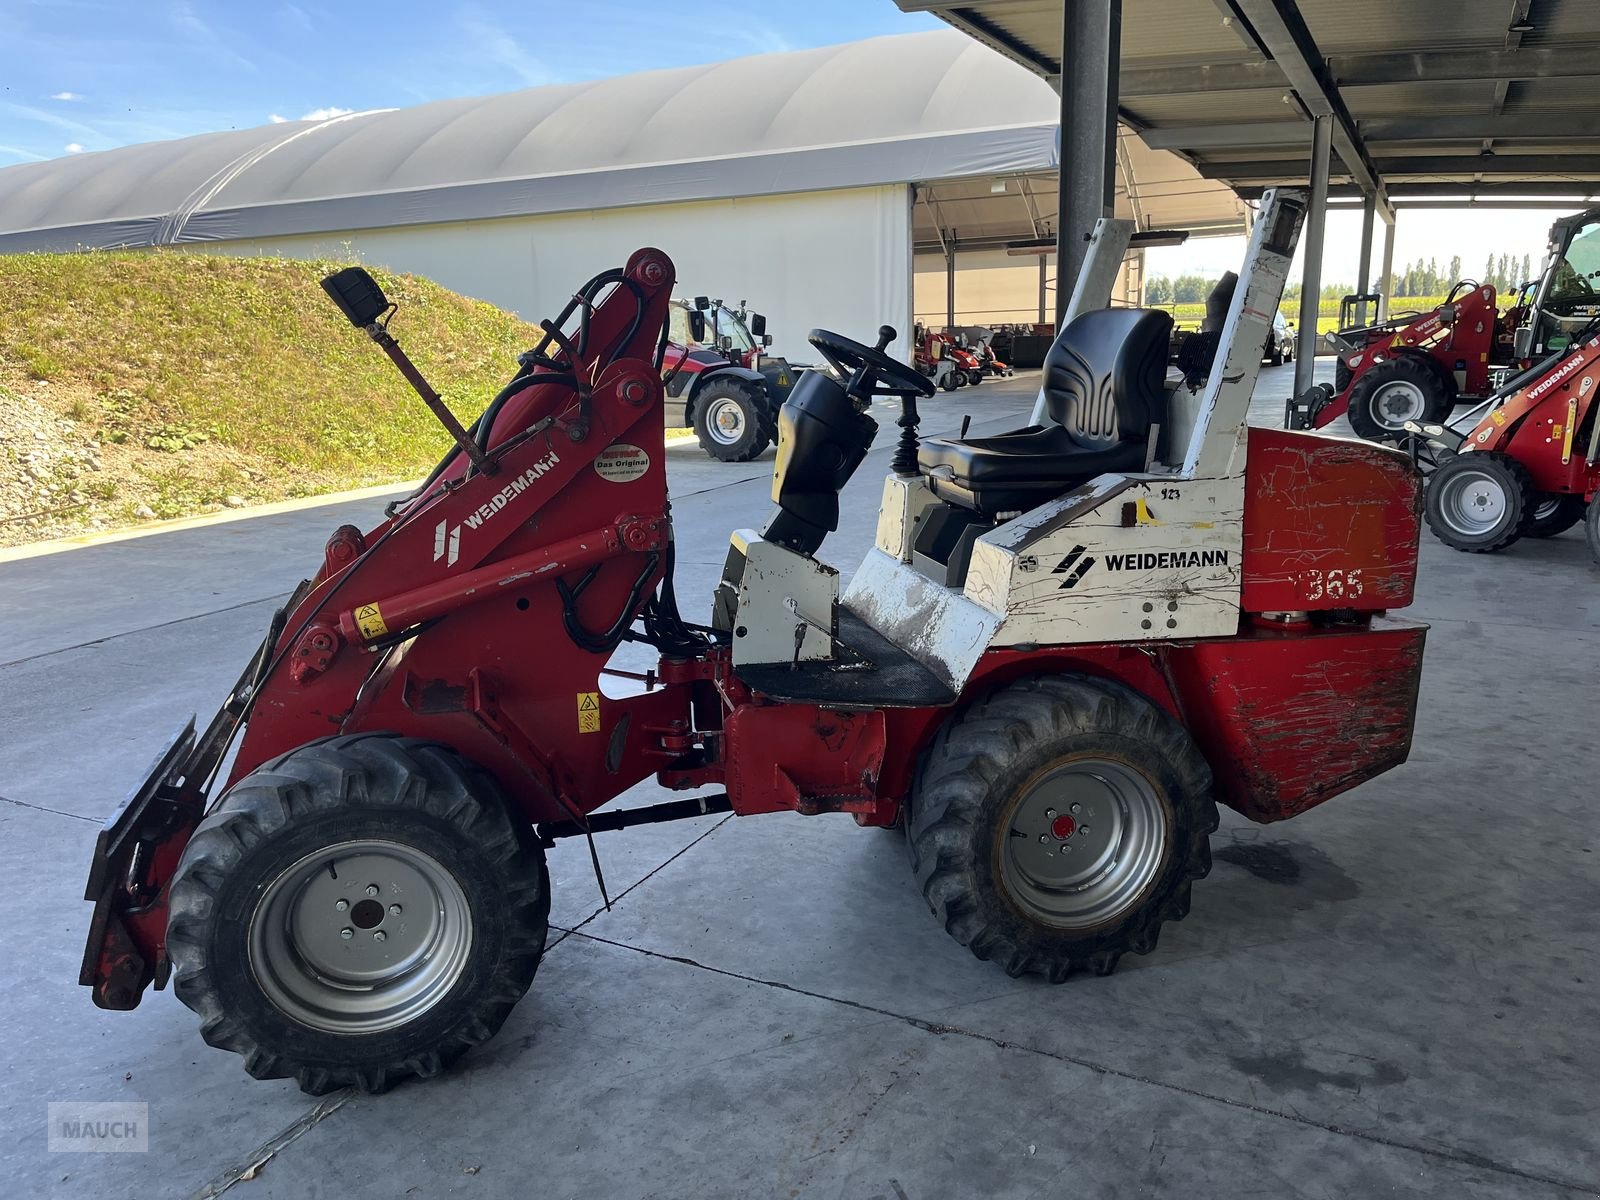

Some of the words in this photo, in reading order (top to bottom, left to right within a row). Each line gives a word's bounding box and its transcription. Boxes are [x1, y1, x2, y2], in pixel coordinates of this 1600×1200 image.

[1527, 354, 1584, 399] WEIDEMANN
[615, 458, 648, 467] Original
[463, 450, 560, 530] WEIDEMANN
[1105, 550, 1228, 571] WEIDEMANN
[1305, 569, 1363, 600] 365
